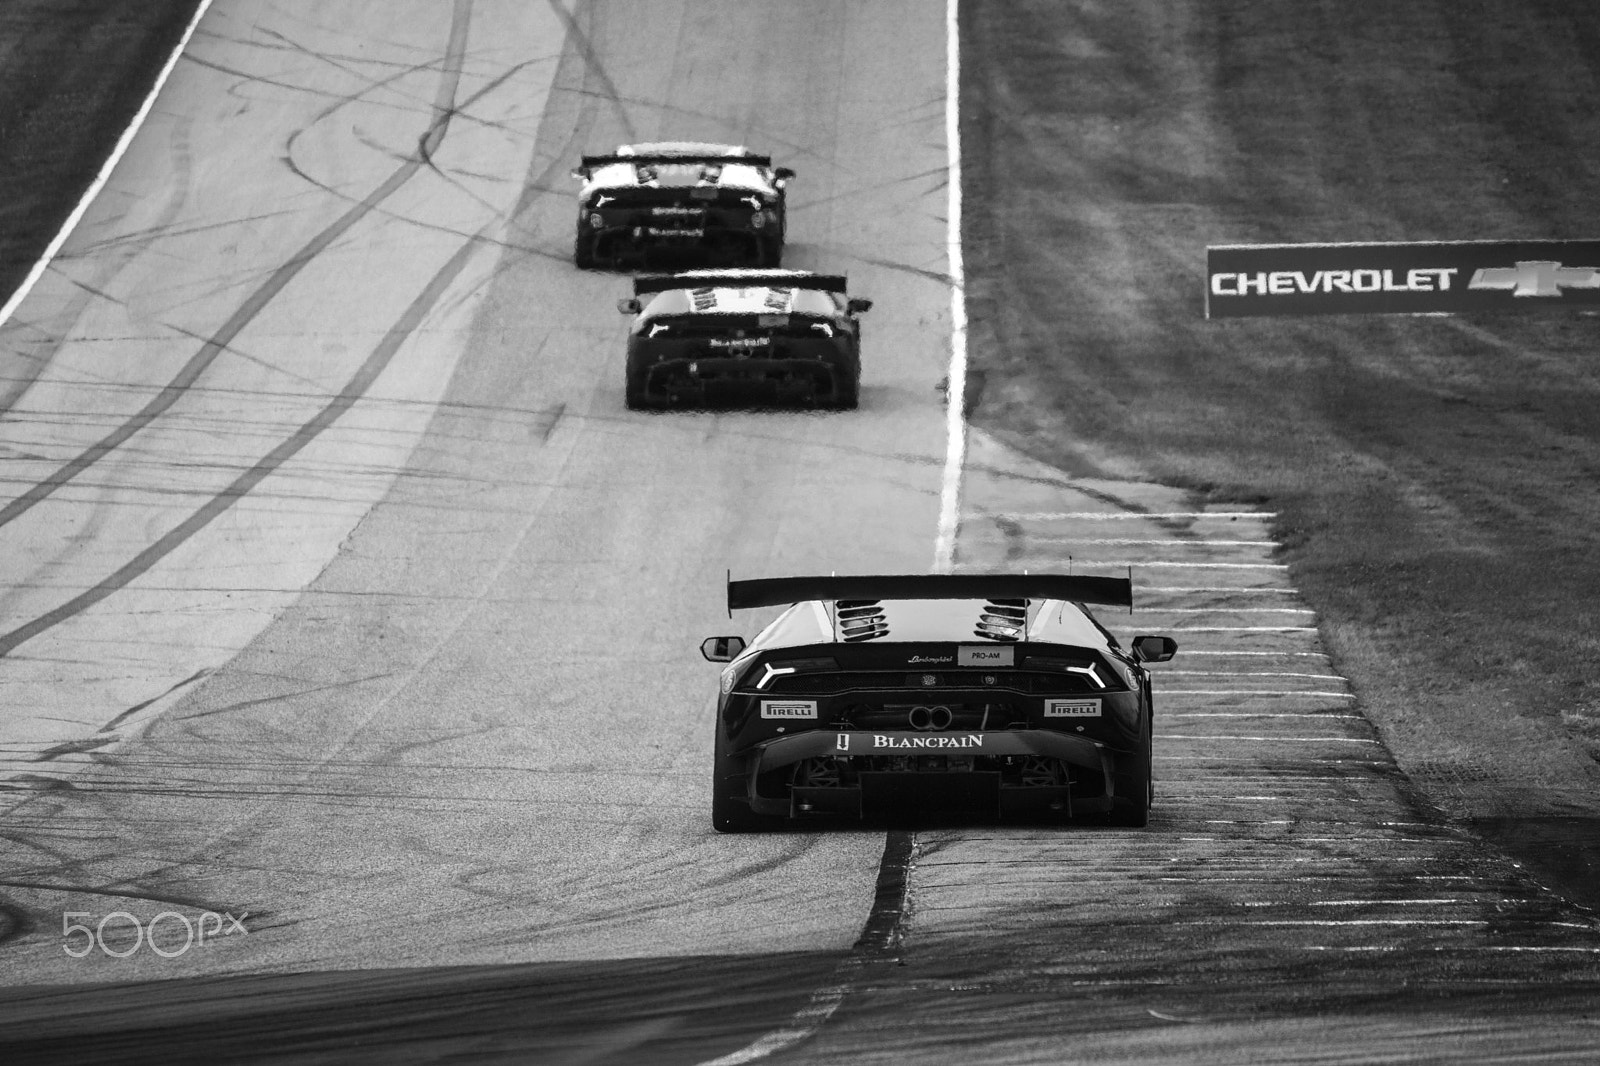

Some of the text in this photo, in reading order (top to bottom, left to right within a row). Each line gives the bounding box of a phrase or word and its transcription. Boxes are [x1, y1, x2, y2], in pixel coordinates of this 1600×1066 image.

[1211, 268, 1458, 296] CHEVROLET
[766, 704, 812, 716] PIRELLI
[1051, 702, 1097, 714] PIRELLI
[873, 734, 984, 748] BLANCPAIN
